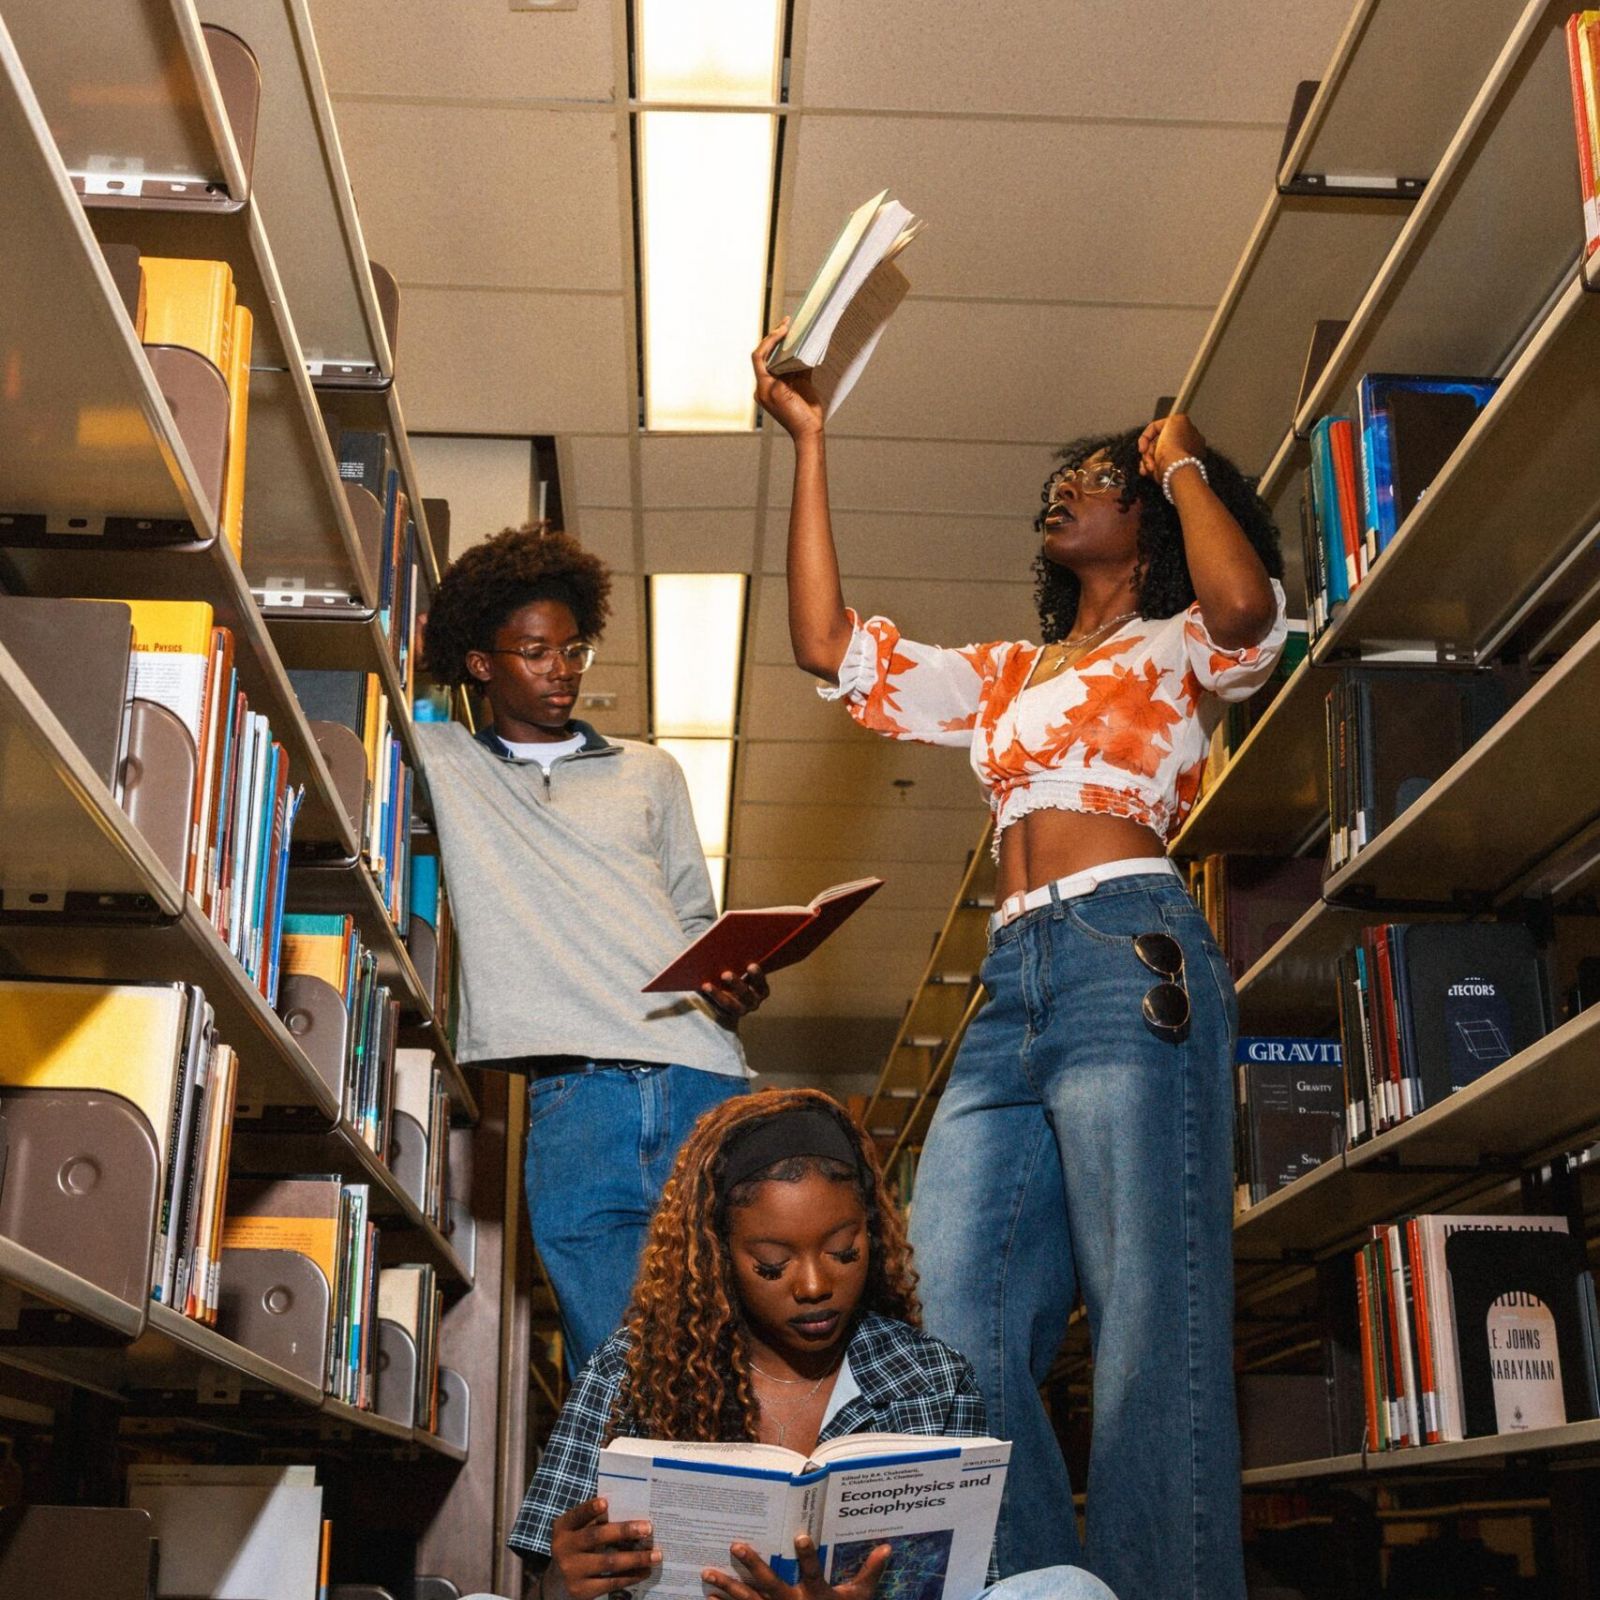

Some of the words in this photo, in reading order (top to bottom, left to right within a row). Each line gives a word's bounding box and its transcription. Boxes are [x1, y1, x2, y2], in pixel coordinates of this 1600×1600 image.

[153, 642, 183, 652] PHYSICS
[1506, 1328, 1541, 1350] JOHNS
[840, 1479, 956, 1503] Econophysics
[959, 1474, 992, 1489] and
[838, 1496, 946, 1518] Sociophysics
